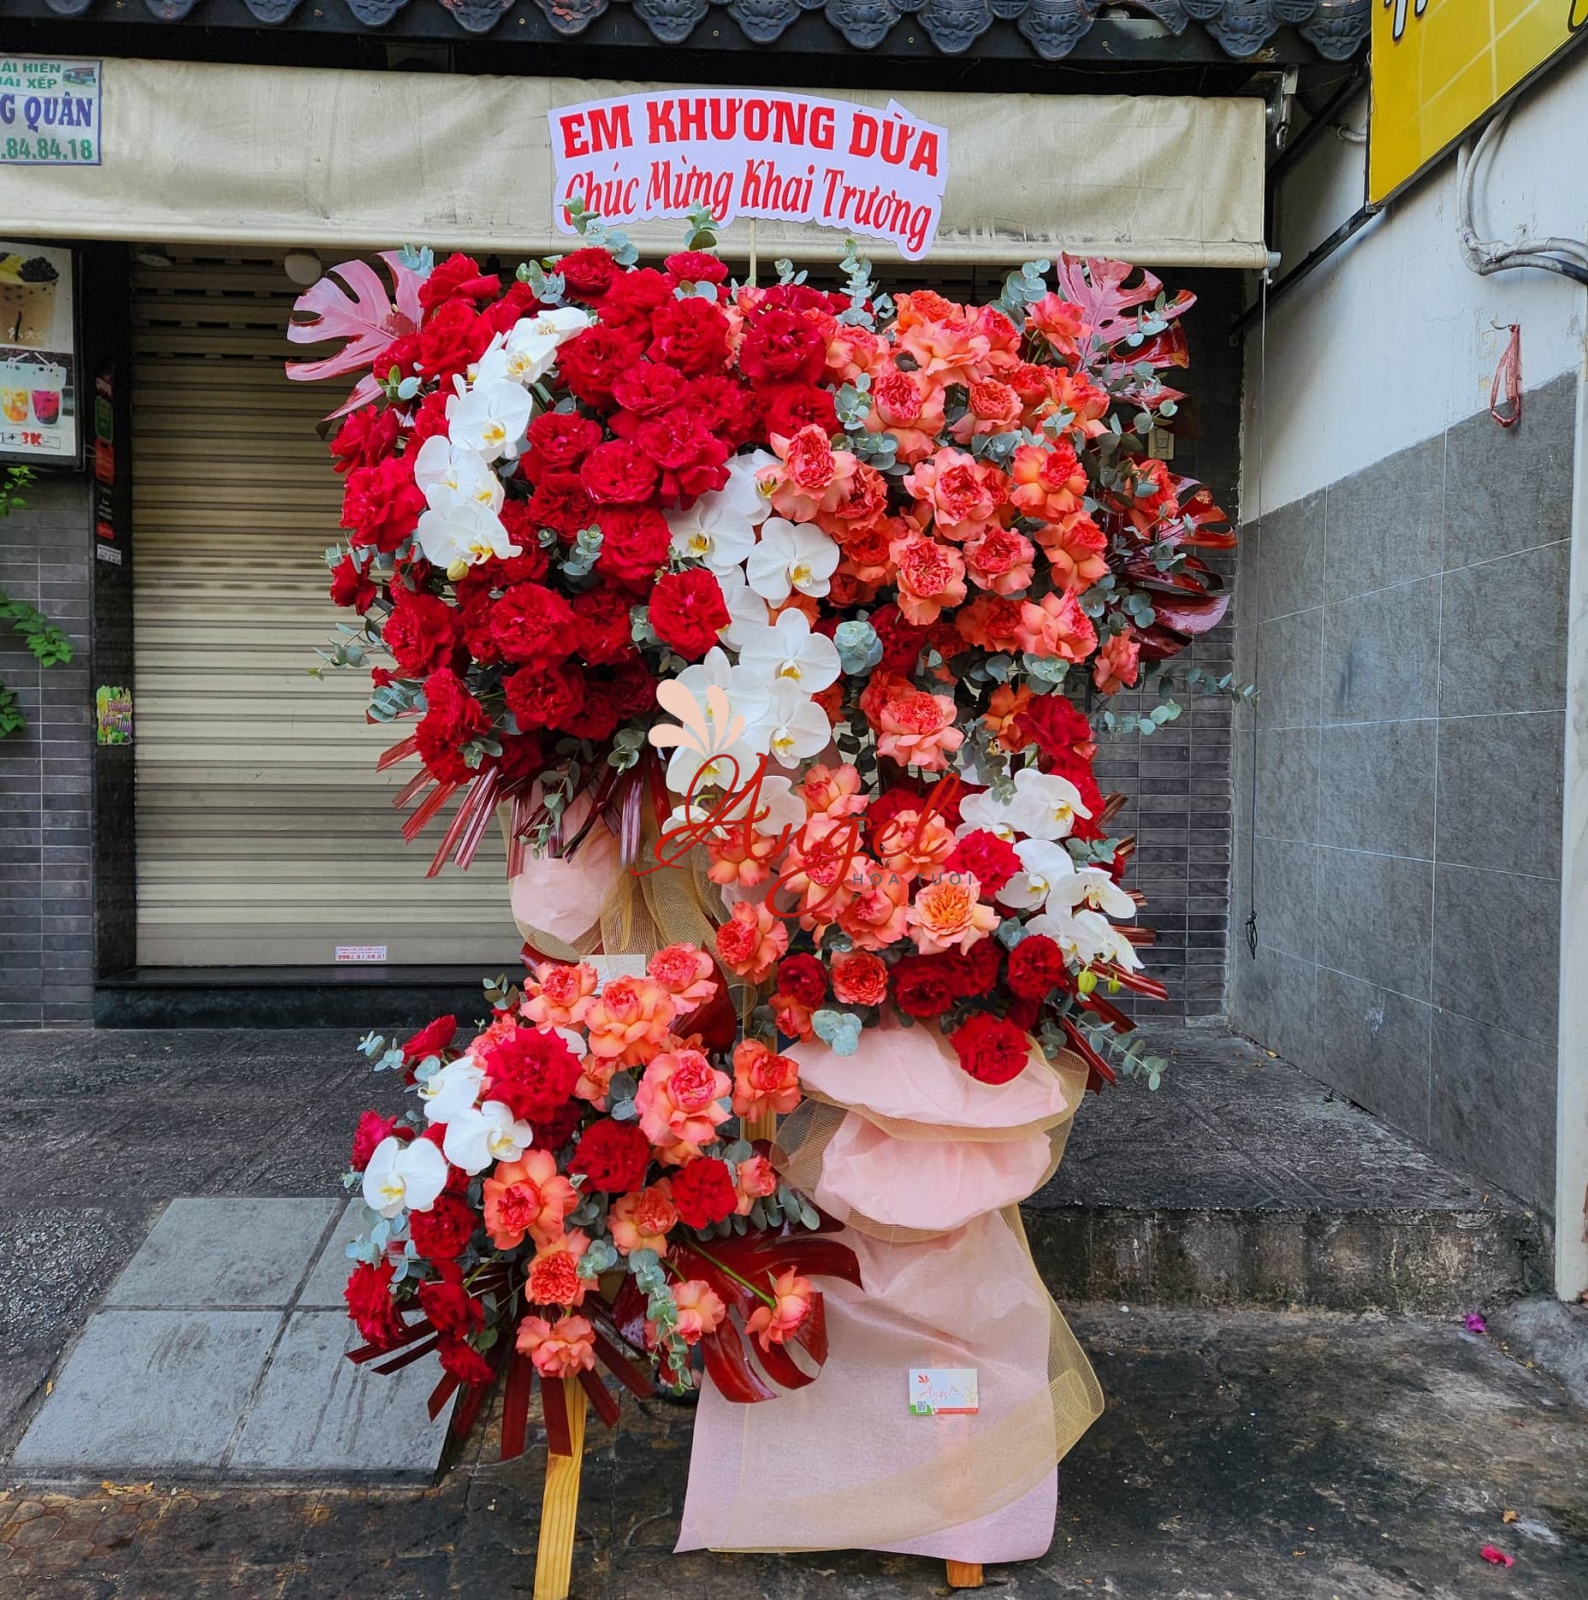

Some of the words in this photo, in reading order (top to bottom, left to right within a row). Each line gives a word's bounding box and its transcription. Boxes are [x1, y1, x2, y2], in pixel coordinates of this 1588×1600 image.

[22, 61, 61, 73] HIÊN
[27, 75, 58, 89] XẾP
[24, 91, 93, 133] QUÂN
[559, 104, 633, 159] EM
[645, 97, 835, 150] KHƯƠNG
[564, 161, 640, 226] Chúc
[645, 155, 734, 222] Mừng
[740, 158, 816, 212] Khai
[822, 167, 933, 253] Trương
